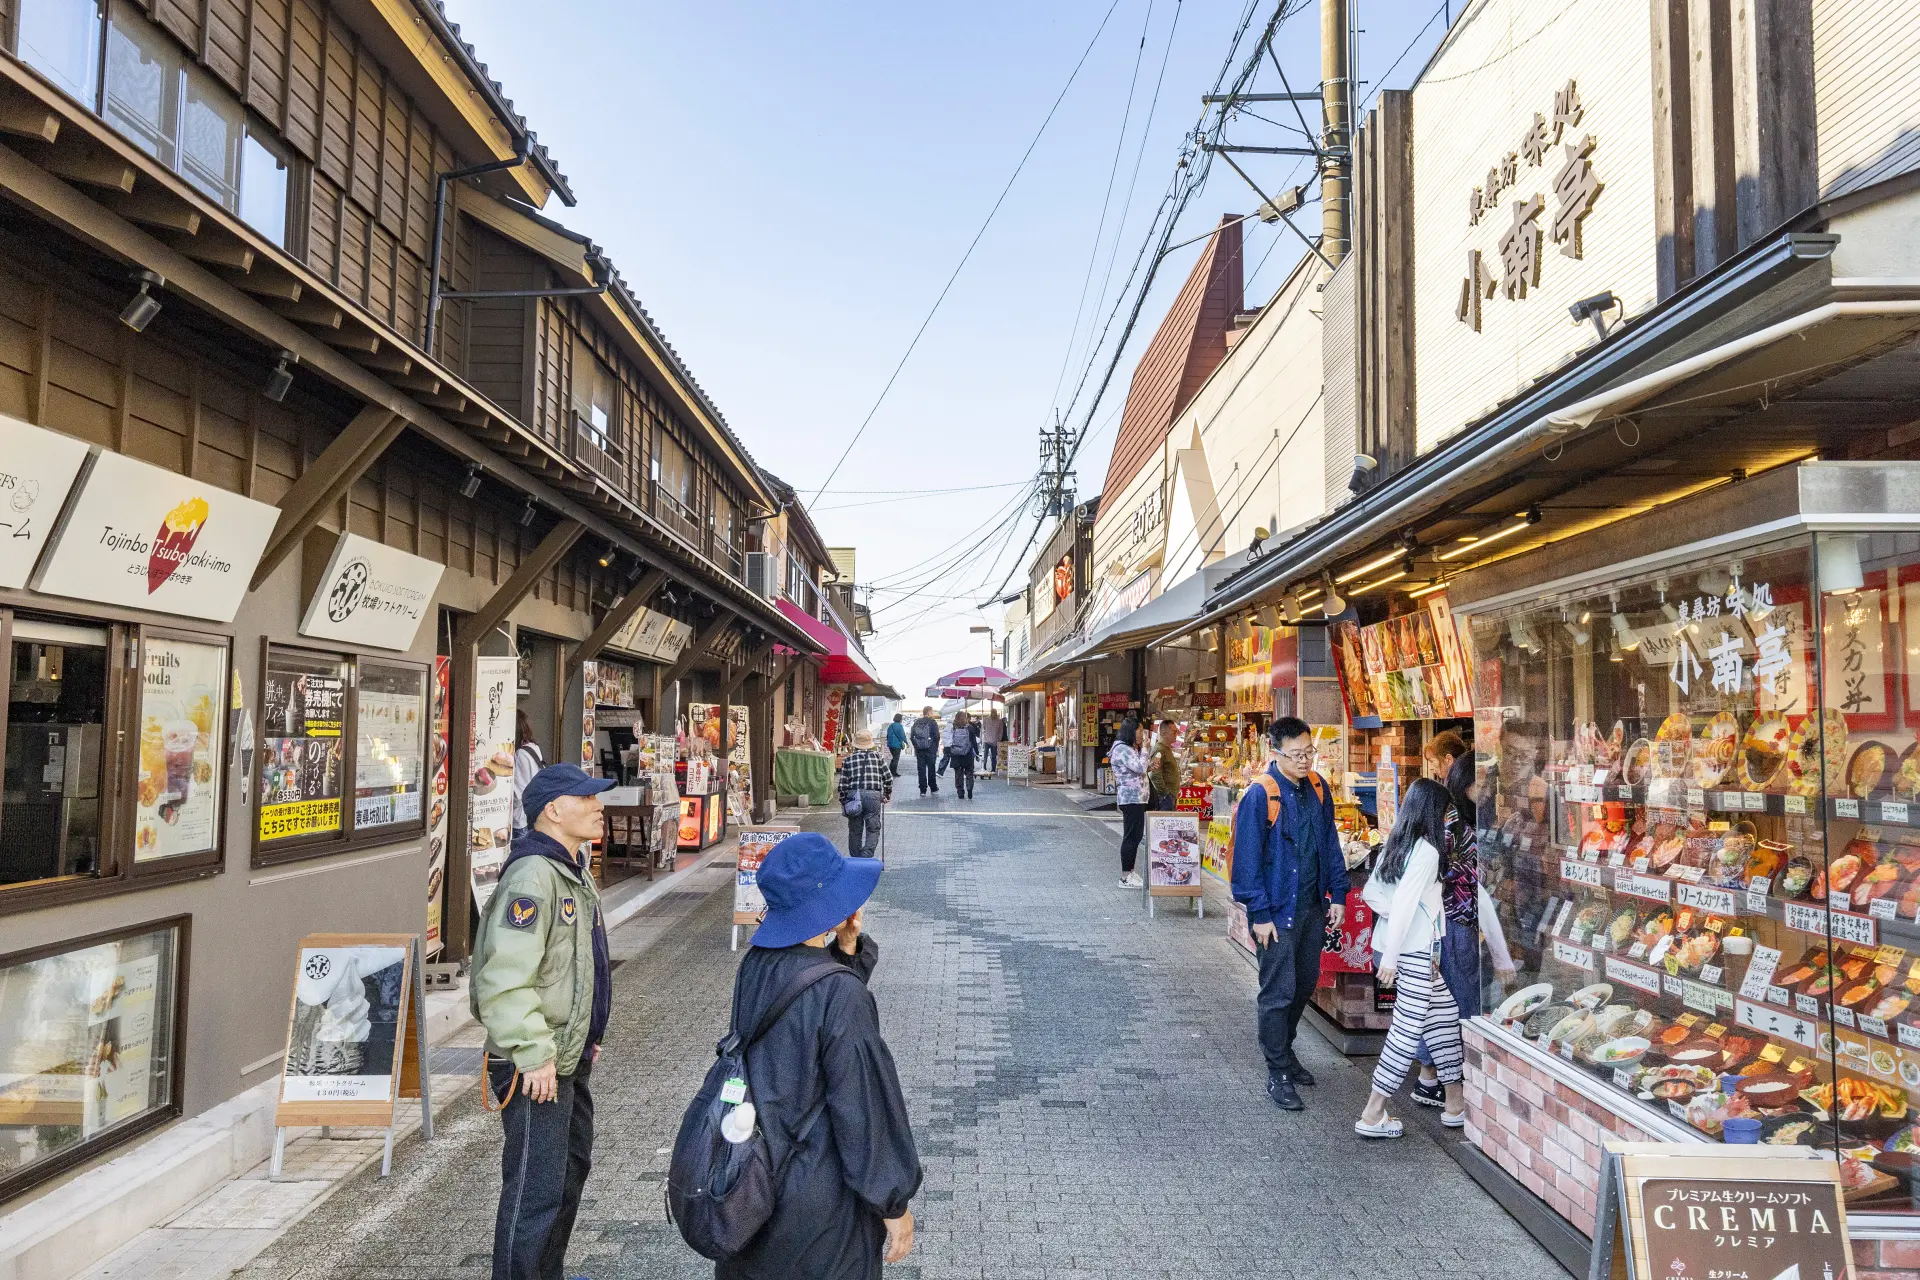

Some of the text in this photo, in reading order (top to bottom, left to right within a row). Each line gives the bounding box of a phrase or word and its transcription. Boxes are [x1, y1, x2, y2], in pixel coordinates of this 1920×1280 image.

[1455, 132, 1605, 334] 小南亭
[99, 525, 231, 573] Tojinbo Tsuboyaki-imo
[361, 594, 419, 620] 牧場ソフトクリーム
[1669, 621, 1792, 696] 小南亭
[305, 689, 344, 708] 券売機にて
[355, 804, 389, 826] 東尋坊BLUE
[1565, 862, 1598, 883] おろしそば
[1680, 887, 1731, 912] ソースカツ丼
[1557, 945, 1589, 966] ラーメン
[1747, 1006, 1806, 1043] ミニ丼
[1667, 1189, 1812, 1204] プレミアム生クリームソフト
[1653, 1204, 1832, 1234] CREMIA
[1715, 1235, 1776, 1248] クレミア
[1708, 1269, 1749, 1279] 生クリーム
